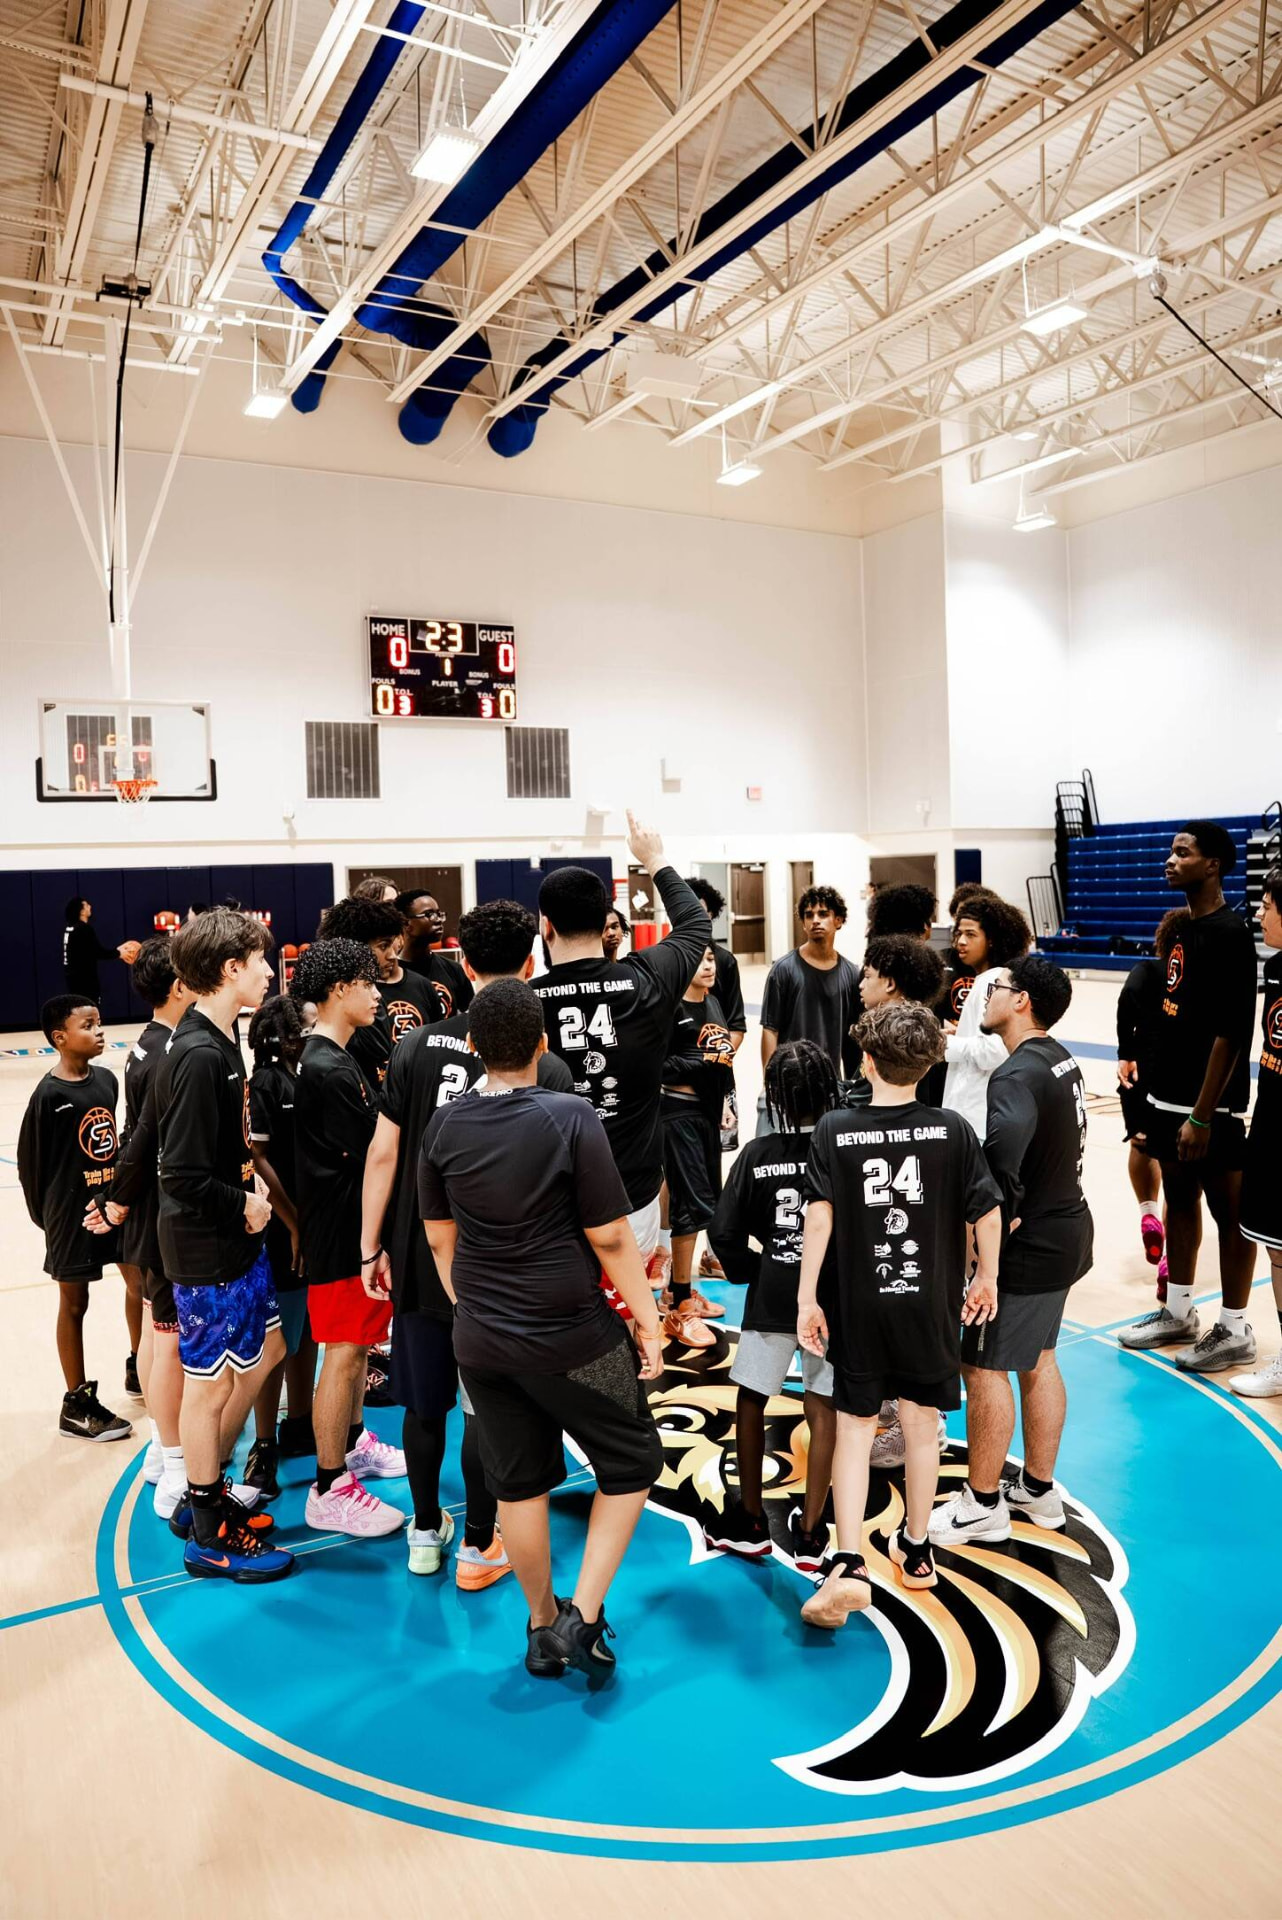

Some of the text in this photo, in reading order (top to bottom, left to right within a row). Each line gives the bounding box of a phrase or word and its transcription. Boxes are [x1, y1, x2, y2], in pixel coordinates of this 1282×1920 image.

[371, 622, 405, 637] HOME
[479, 629, 514, 643] GUEST
[389, 636, 407, 668] 0
[498, 643, 515, 673] 0
[371, 677, 396, 686] FOULS
[399, 668, 421, 676] BONUS
[468, 671, 490, 679] BONUS
[431, 680, 459, 688] PLAYER
[493, 682, 515, 690] FOULS
[376, 684, 395, 716] 0
[399, 695, 412, 716] 3
[481, 698, 493, 718] 3
[500, 689, 516, 719] 0
[578, 982, 601, 994] THE
[603, 979, 635, 993] GAME
[557, 1003, 618, 1051] 24
[426, 1034, 470, 1054] BEYOND
[836, 1126, 948, 1147] BEYOND THE GAME
[753, 1164, 797, 1179] BEYOND
[862, 1155, 924, 1207] 24
